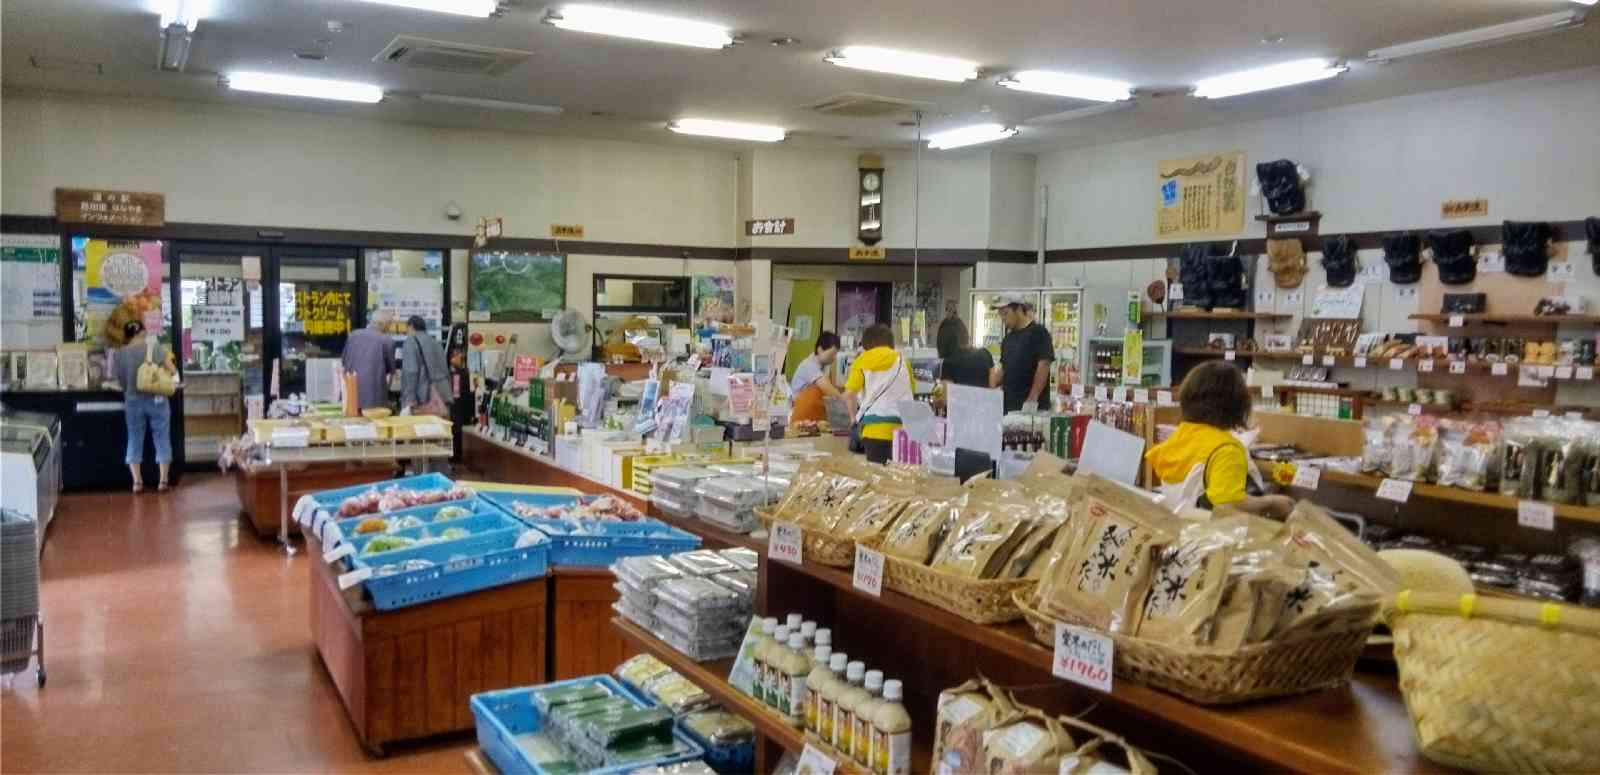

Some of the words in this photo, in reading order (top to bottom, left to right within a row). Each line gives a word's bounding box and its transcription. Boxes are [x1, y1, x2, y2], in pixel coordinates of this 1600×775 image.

[751, 220, 786, 234] お会計
[1060, 657, 1108, 681] ¥1960
